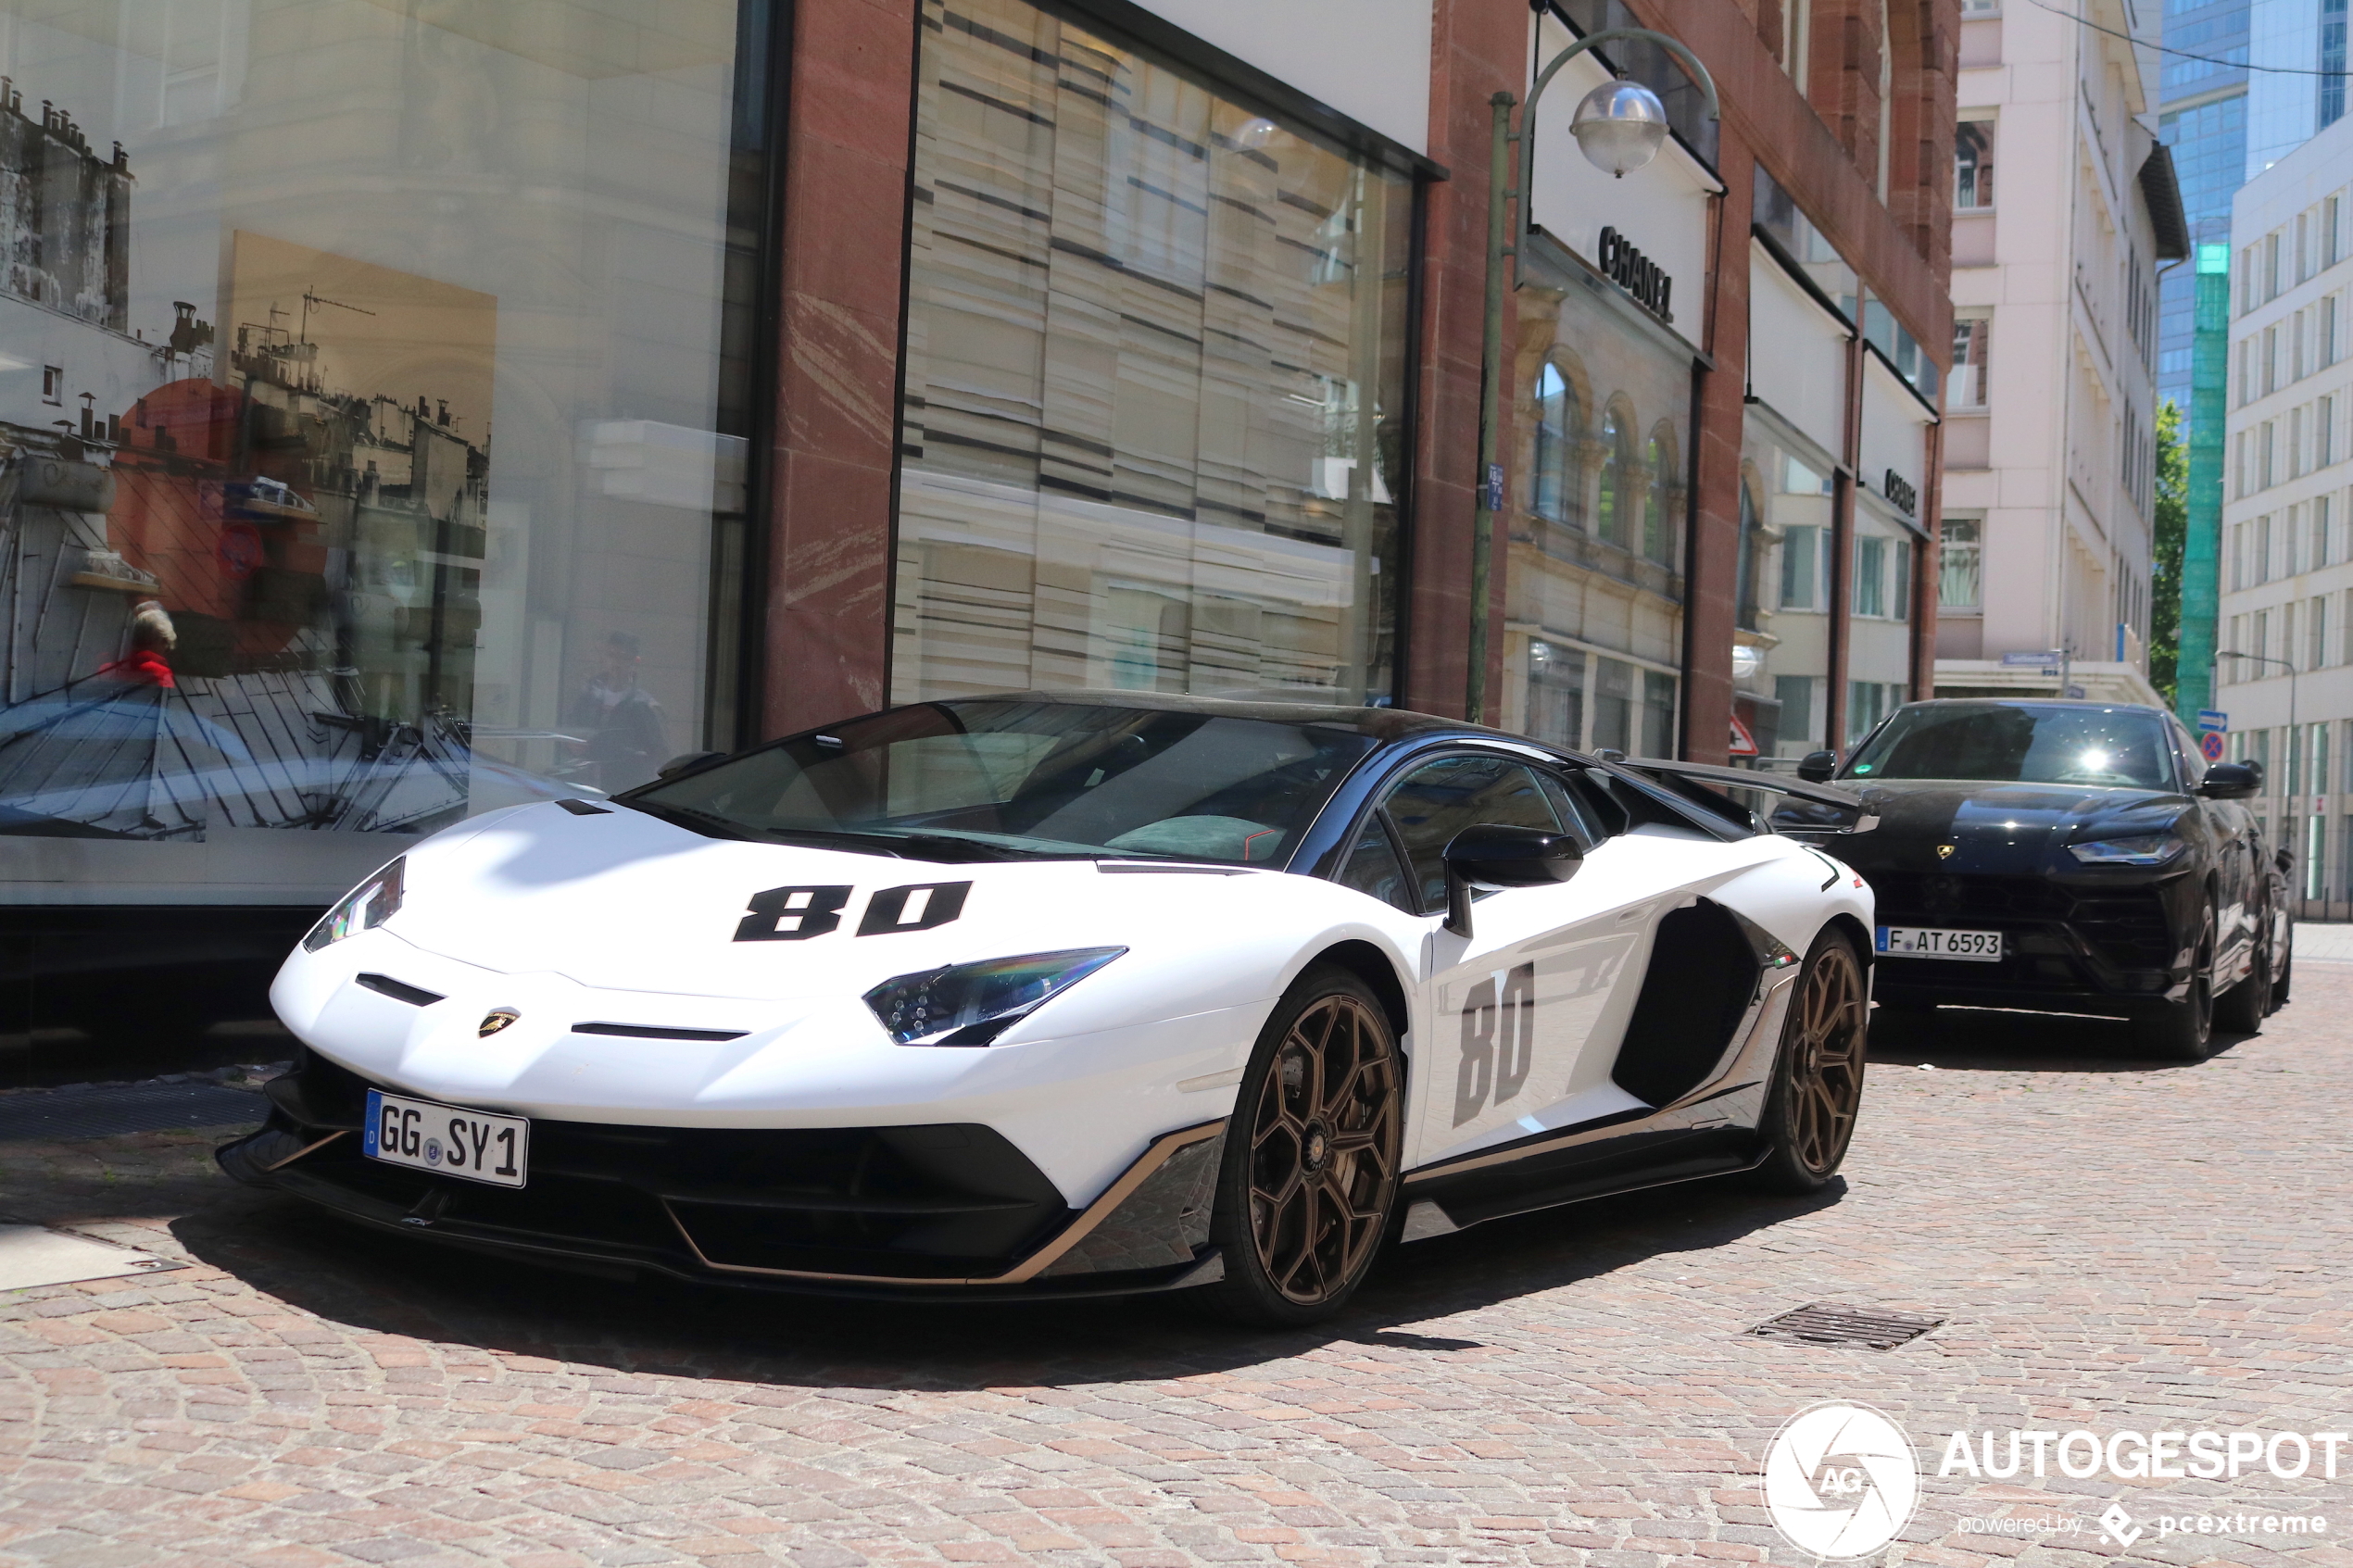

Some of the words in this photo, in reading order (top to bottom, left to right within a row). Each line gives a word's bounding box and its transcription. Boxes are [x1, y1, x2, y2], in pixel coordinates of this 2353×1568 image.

[1598, 226, 1674, 323] CHANEL
[731, 881, 975, 943] 80
[1890, 930, 1903, 949] F
[1917, 931, 1943, 951] AT
[1947, 933, 1999, 954] 6593
[1452, 959, 1535, 1130] 80
[380, 1105, 422, 1158] GG
